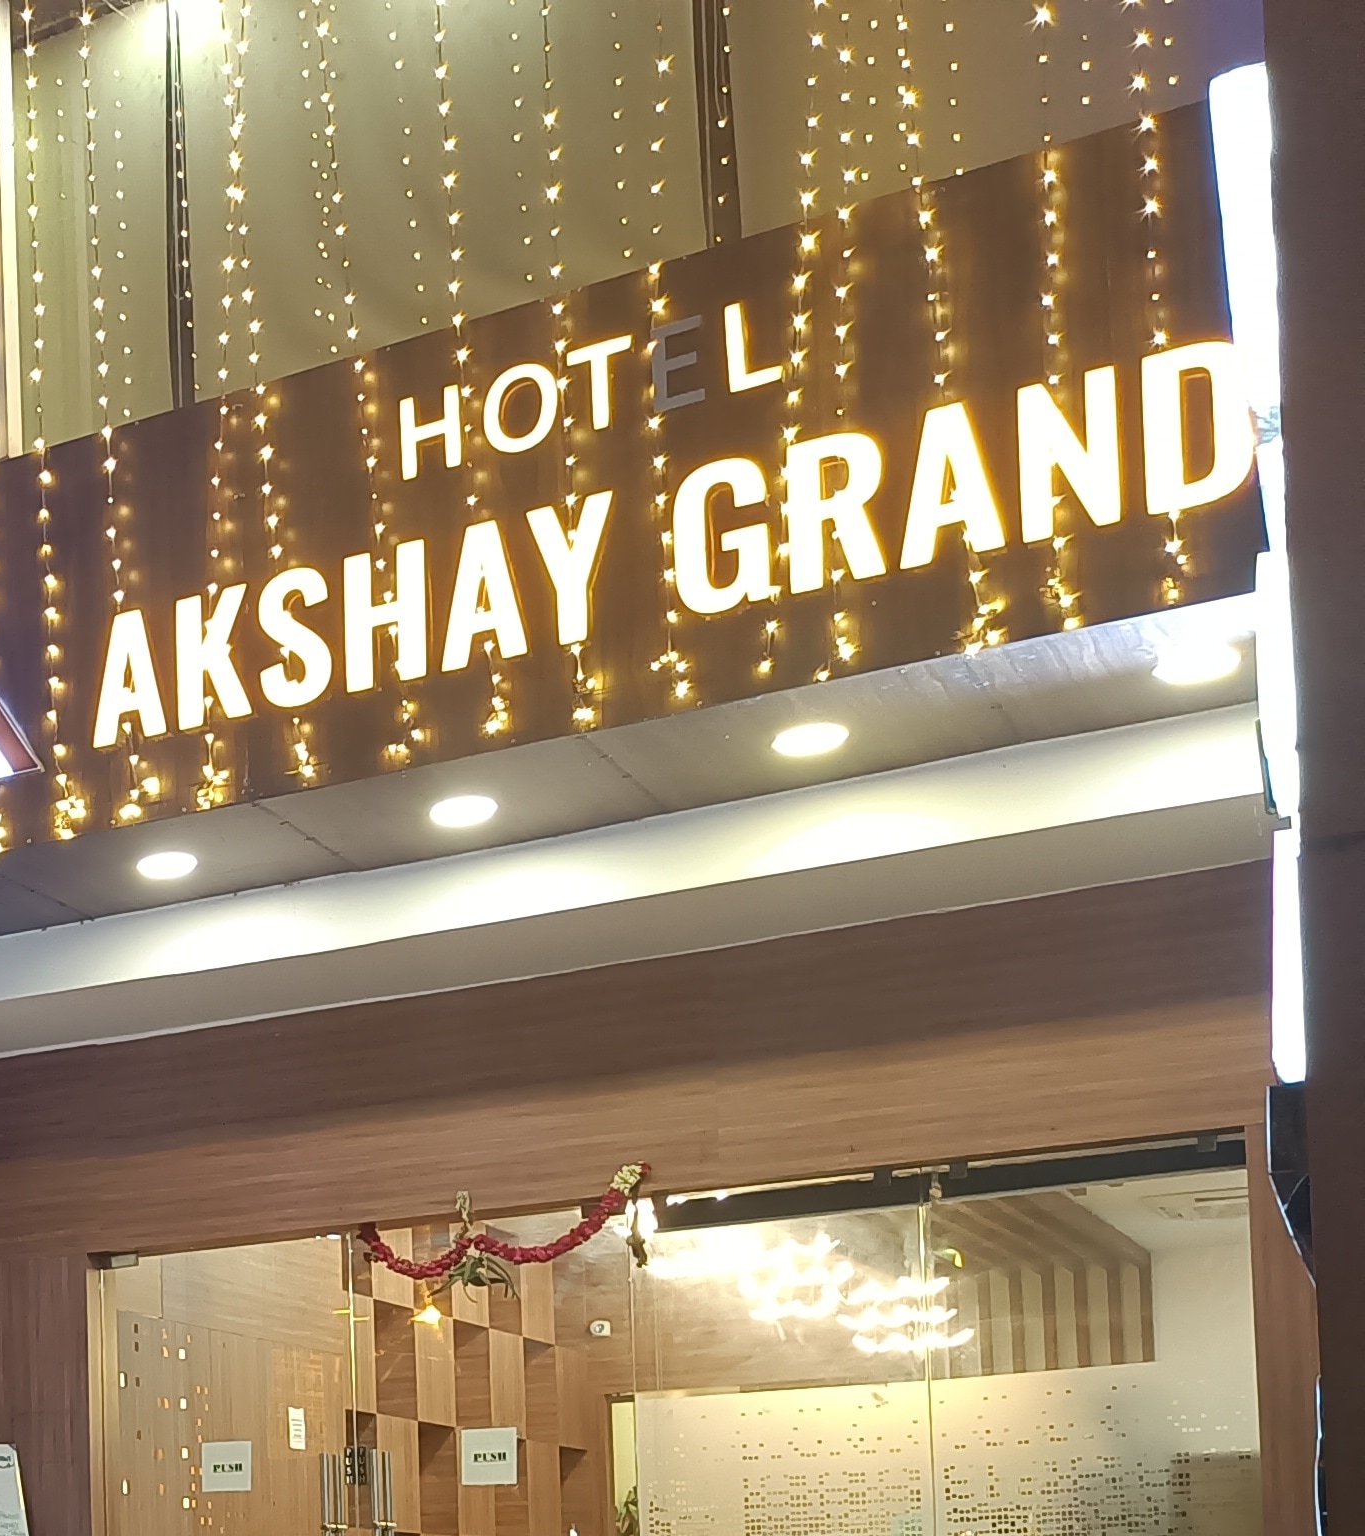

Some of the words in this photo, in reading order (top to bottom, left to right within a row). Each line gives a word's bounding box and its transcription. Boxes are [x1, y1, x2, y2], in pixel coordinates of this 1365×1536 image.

[399, 302, 784, 481] HOTEL
[92, 490, 615, 750] AKSHAY
[671, 339, 1257, 614] GRAND
[212, 1462, 243, 1473] PUSH
[346, 1447, 354, 1484] PUSH
[473, 1451, 507, 1462] PUSH
